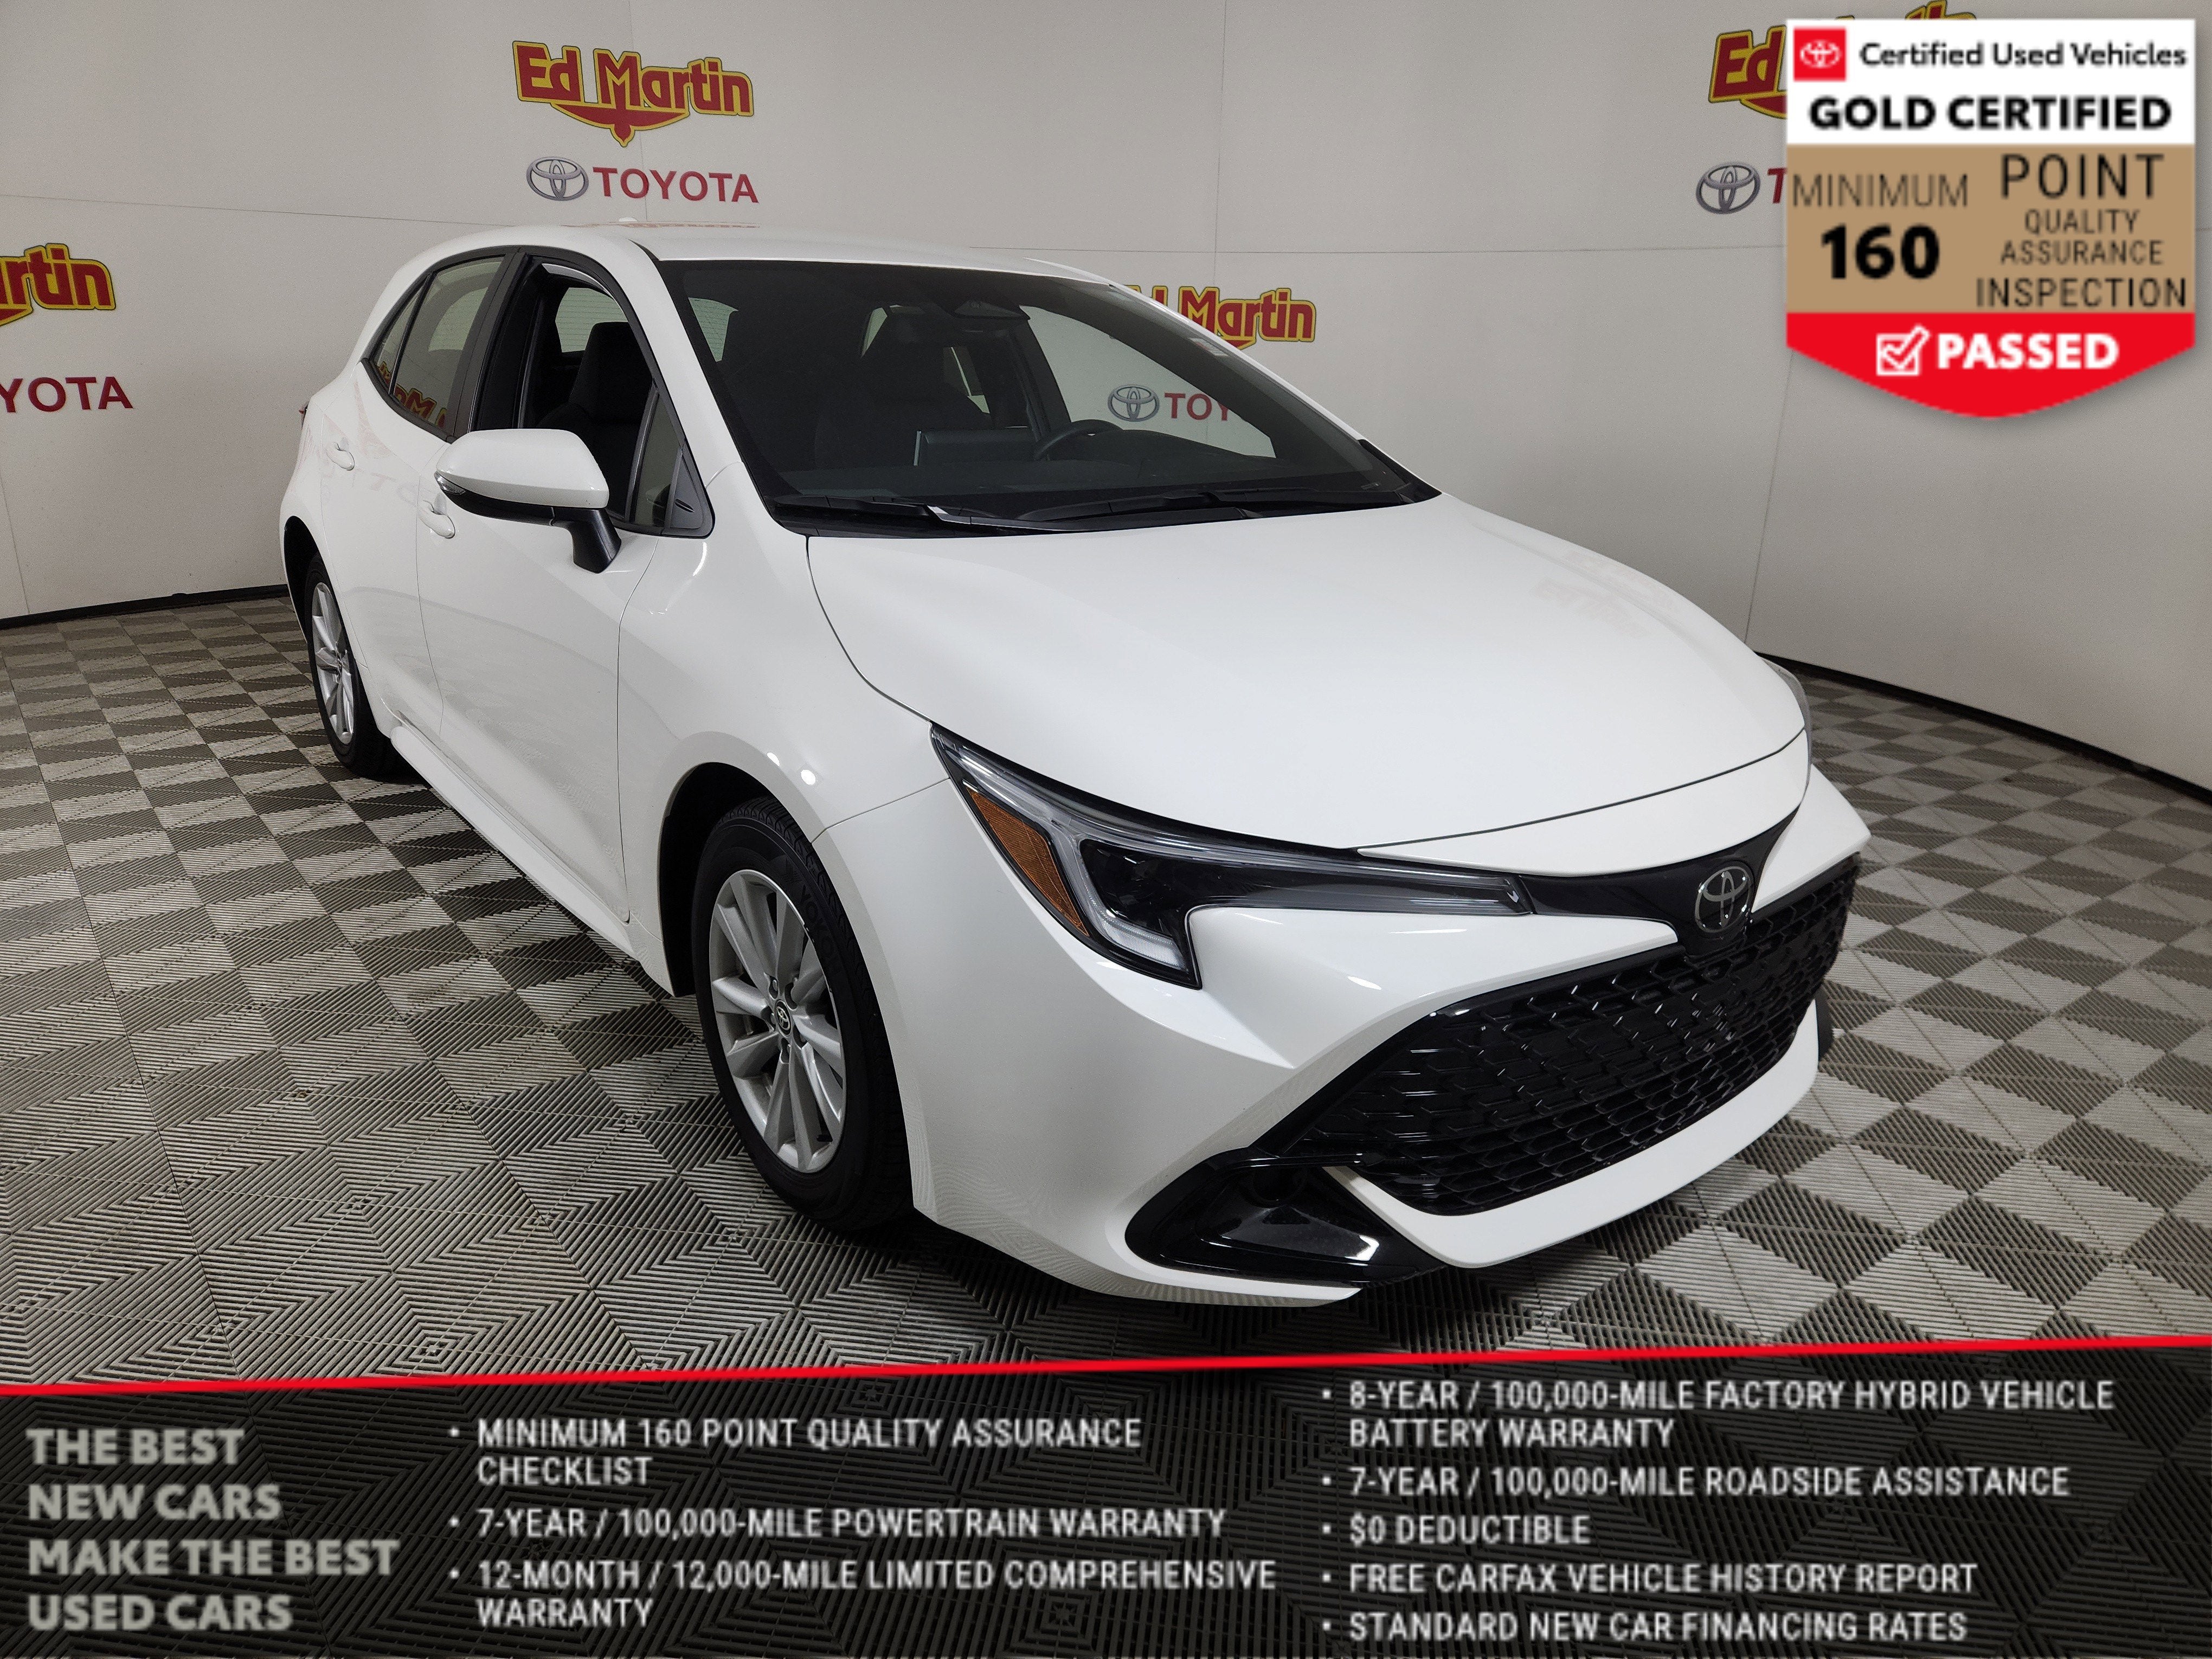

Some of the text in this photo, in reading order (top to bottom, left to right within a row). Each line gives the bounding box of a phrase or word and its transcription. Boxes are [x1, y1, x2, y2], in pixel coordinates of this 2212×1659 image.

[513, 41, 754, 117] Ed Martin
[1709, 25, 1786, 103] Ed
[593, 166, 759, 203] TOYOTA
[0, 243, 116, 310] rtin
[1178, 286, 1316, 343] Martin
[0, 376, 133, 413] YOTA
[1164, 392, 1230, 421] TOY
